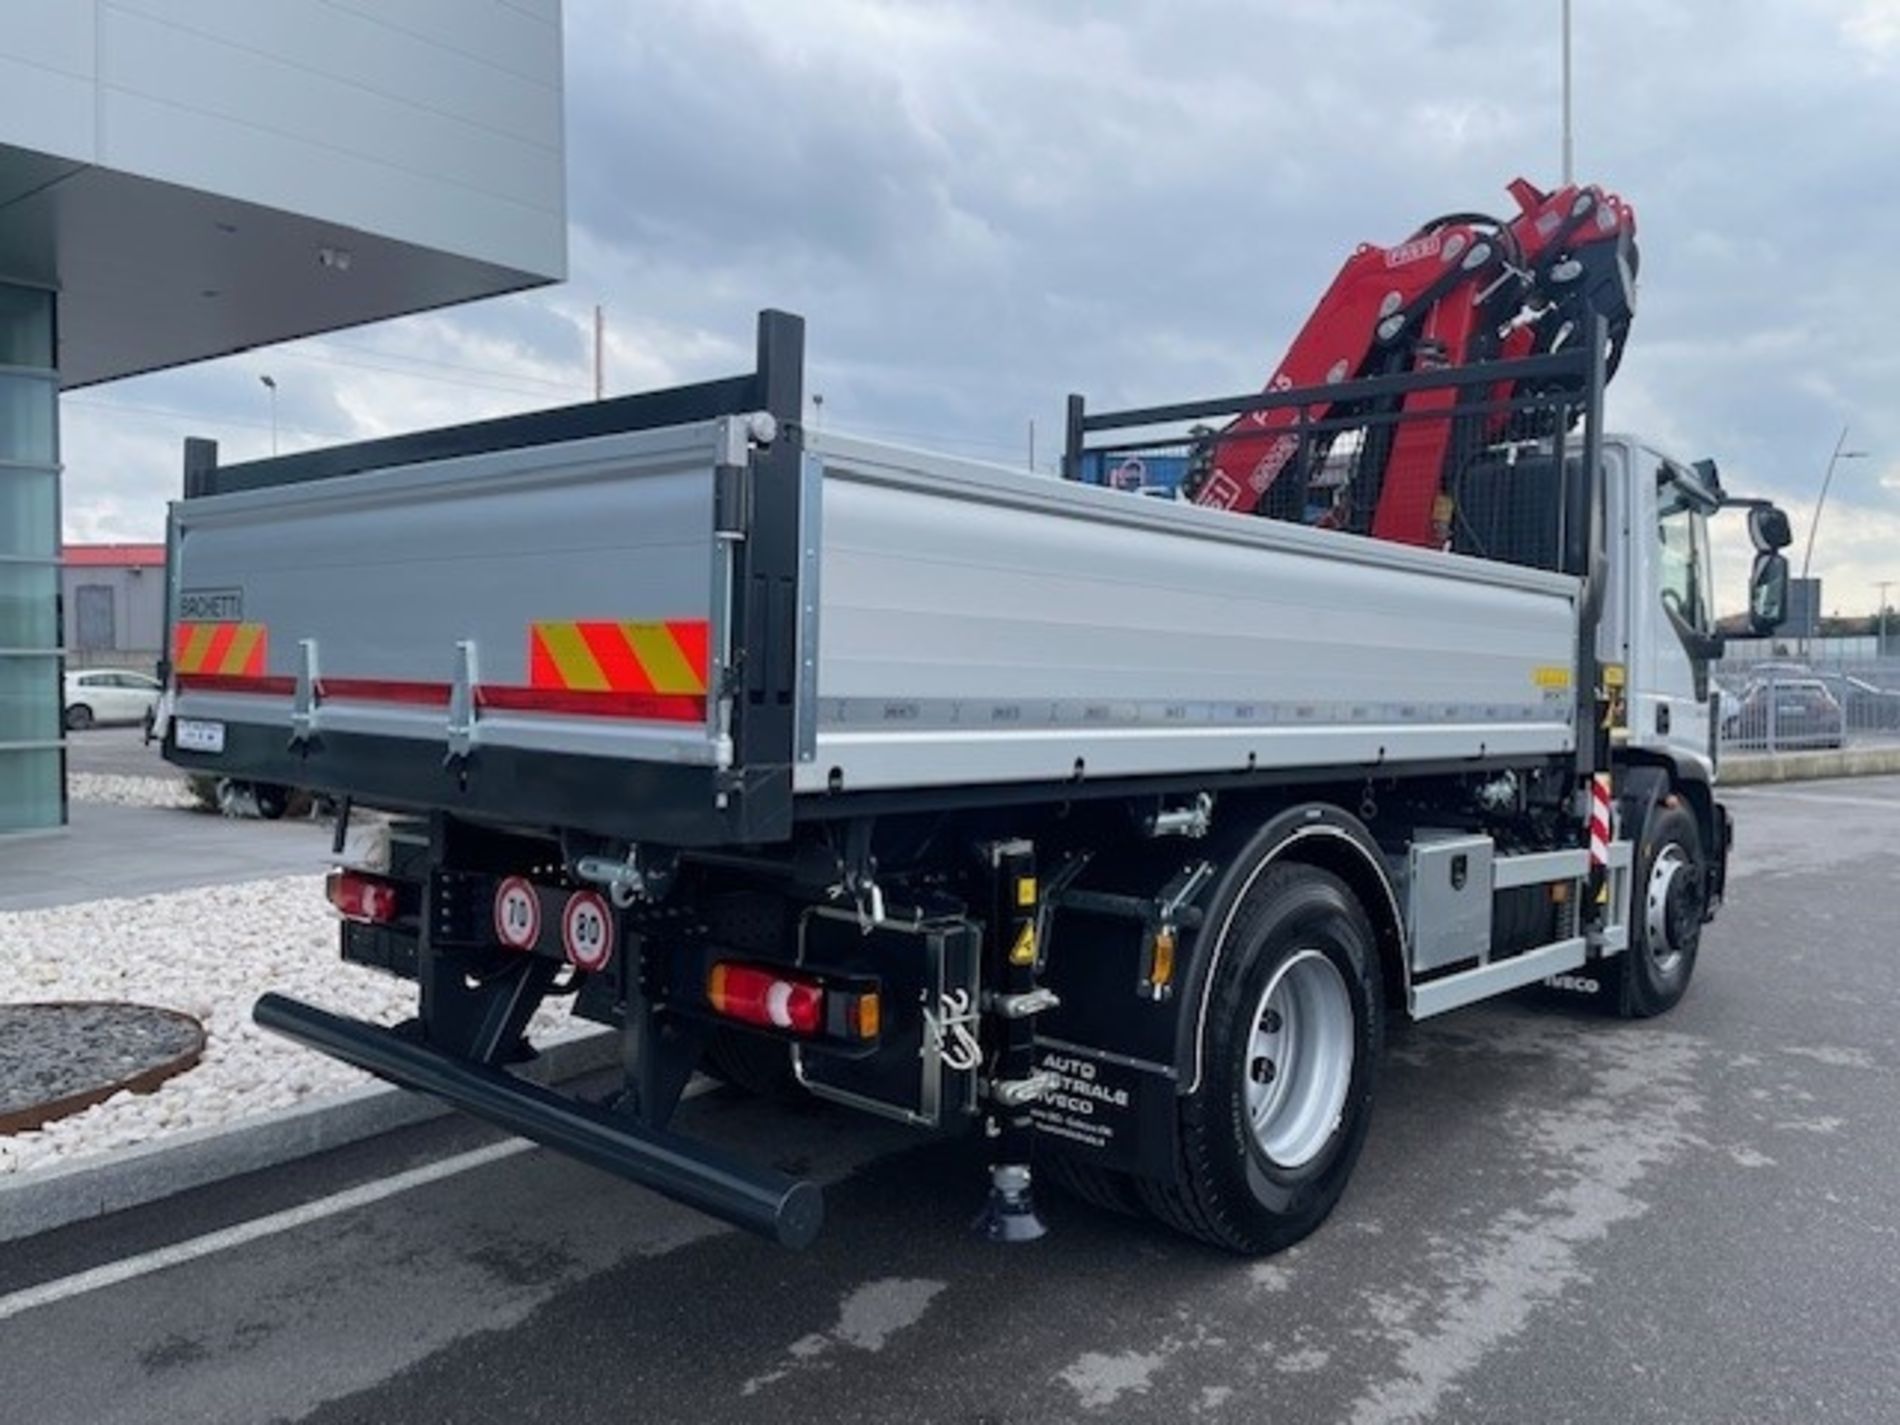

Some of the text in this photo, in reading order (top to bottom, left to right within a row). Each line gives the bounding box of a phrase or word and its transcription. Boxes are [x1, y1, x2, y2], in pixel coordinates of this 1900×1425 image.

[508, 897, 528, 928] 70
[577, 912, 599, 945] 80
[1544, 974, 1599, 994] IVECO
[1042, 1053, 1096, 1079] AUTO
